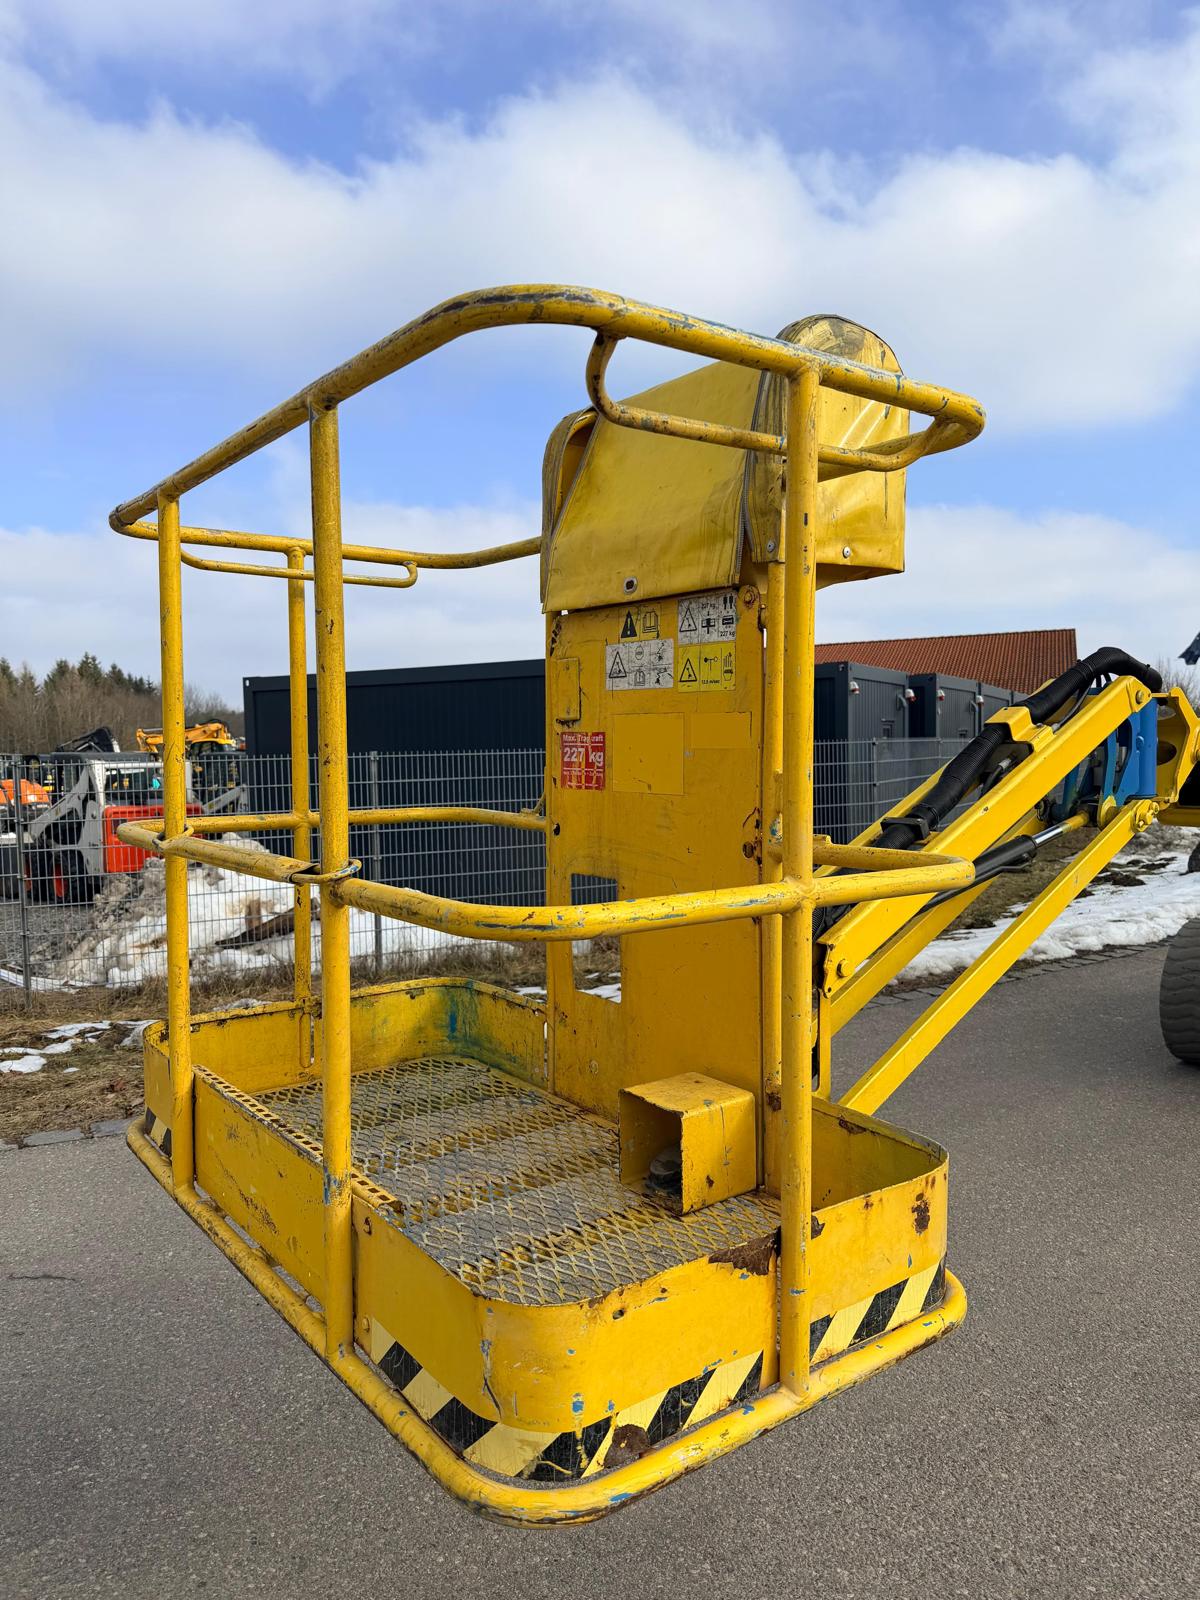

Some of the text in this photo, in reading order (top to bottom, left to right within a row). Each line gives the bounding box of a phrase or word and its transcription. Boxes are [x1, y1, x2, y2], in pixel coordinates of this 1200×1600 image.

[729, 630, 735, 638] kg
[563, 734, 576, 742] Max.
[563, 746, 604, 767] 227 kg
